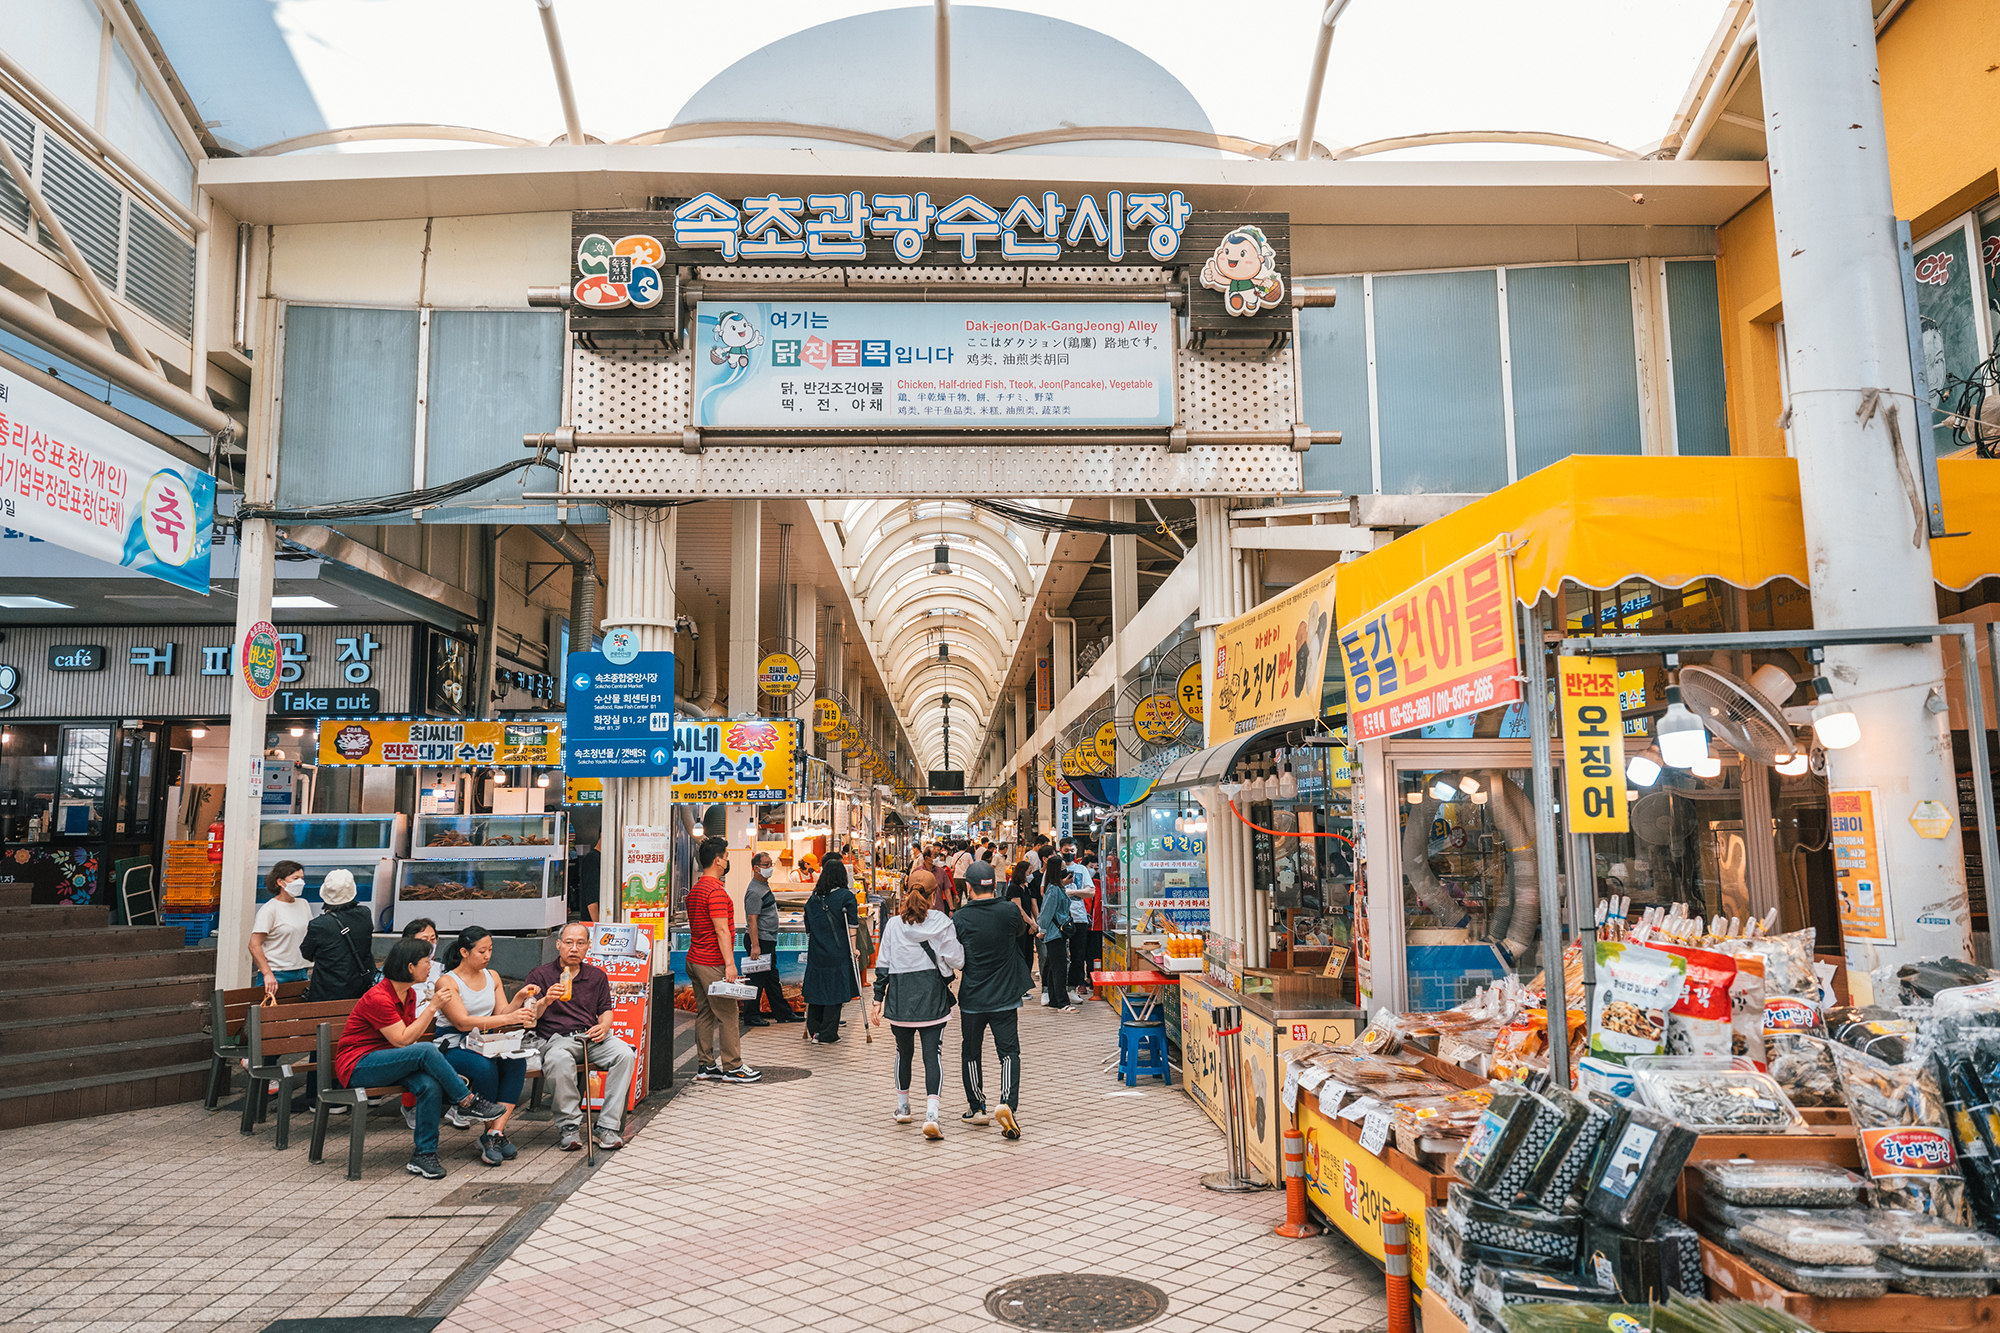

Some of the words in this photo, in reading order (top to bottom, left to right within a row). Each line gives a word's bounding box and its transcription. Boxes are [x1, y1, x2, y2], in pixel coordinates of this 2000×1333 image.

[673, 190, 1193, 263] 속초관광수산시장
[770, 311, 829, 329] 여기는
[966, 320, 1125, 333] Dak-jeon(Dak-GangJeong)
[1128, 320, 1158, 333] Alley
[780, 381, 798, 396] 닭,
[803, 381, 884, 395] 반건조건어물
[897, 380, 937, 391] Chicken,
[938, 380, 983, 389] Half-dried
[985, 380, 1007, 391] Fish,
[1009, 380, 1037, 391] Tteok,
[1038, 380, 1108, 391] Jeon(Pancake),
[1109, 380, 1153, 391] Vegetable
[150, 486, 186, 553] 축
[1341, 551, 1504, 703] 동길건어물
[54, 648, 93, 669] café
[249, 644, 276, 669] 버스킹
[243, 665, 265, 698] BUSKING
[266, 673, 280, 697] ZONE
[254, 665, 271, 680] 공연장
[595, 673, 658, 683] 속초종합중앙시장
[786, 674, 799, 682] 수산
[517, 671, 554, 700] 커피공장
[1565, 673, 1615, 697] 반건조
[282, 692, 330, 711] Take
[335, 692, 371, 710] out
[594, 694, 621, 704] 수산물
[623, 694, 649, 704] 회센터
[650, 695, 661, 703] B1
[1159, 700, 1172, 709] 54
[1362, 711, 1386, 736] 전국택배
[1390, 694, 1431, 728] 033-633-2660
[1437, 674, 1494, 715] 010-8375-2665
[593, 715, 620, 724] 화장실
[636, 716, 647, 724] 2F
[409, 724, 464, 743] 최씨네
[382, 743, 454, 761] 찐찐대게
[458, 743, 495, 761] 수산
[574, 749, 615, 758] 속초청년몰
[1577, 705, 1616, 818] 오징어
[709, 756, 763, 782] 수산
[749, 790, 784, 799] 포장전문
[1163, 835, 1203, 854] 막걸리
[627, 853, 664, 863] 설악문화제
[1680, 984, 1712, 1009] 부각
[1881, 1138, 1951, 1165] 황태껍질
